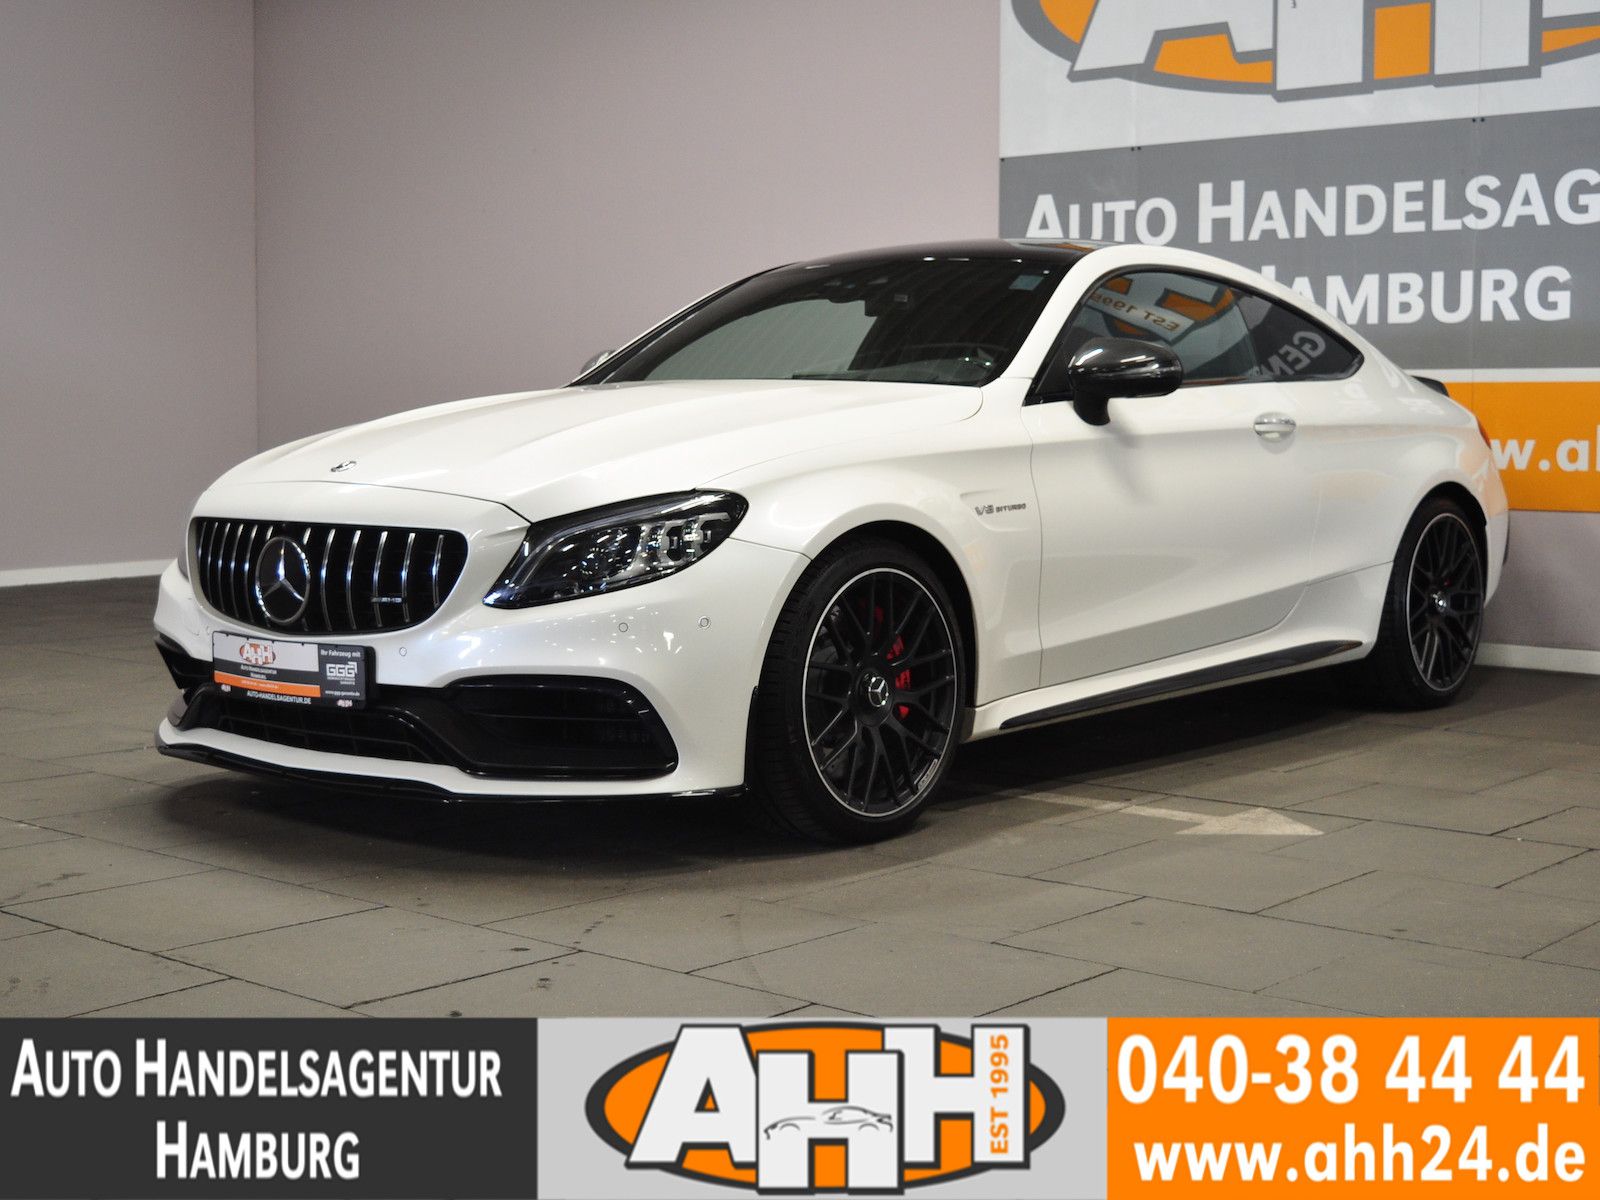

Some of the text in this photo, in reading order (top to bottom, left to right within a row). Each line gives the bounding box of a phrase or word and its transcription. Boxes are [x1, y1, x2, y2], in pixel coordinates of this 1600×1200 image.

[1025, 168, 1600, 246] AUTO HANDELSAG
[1261, 265, 1572, 327] MBURG
[1490, 424, 1600, 472] w.a
[326, 662, 357, 677] GGG
